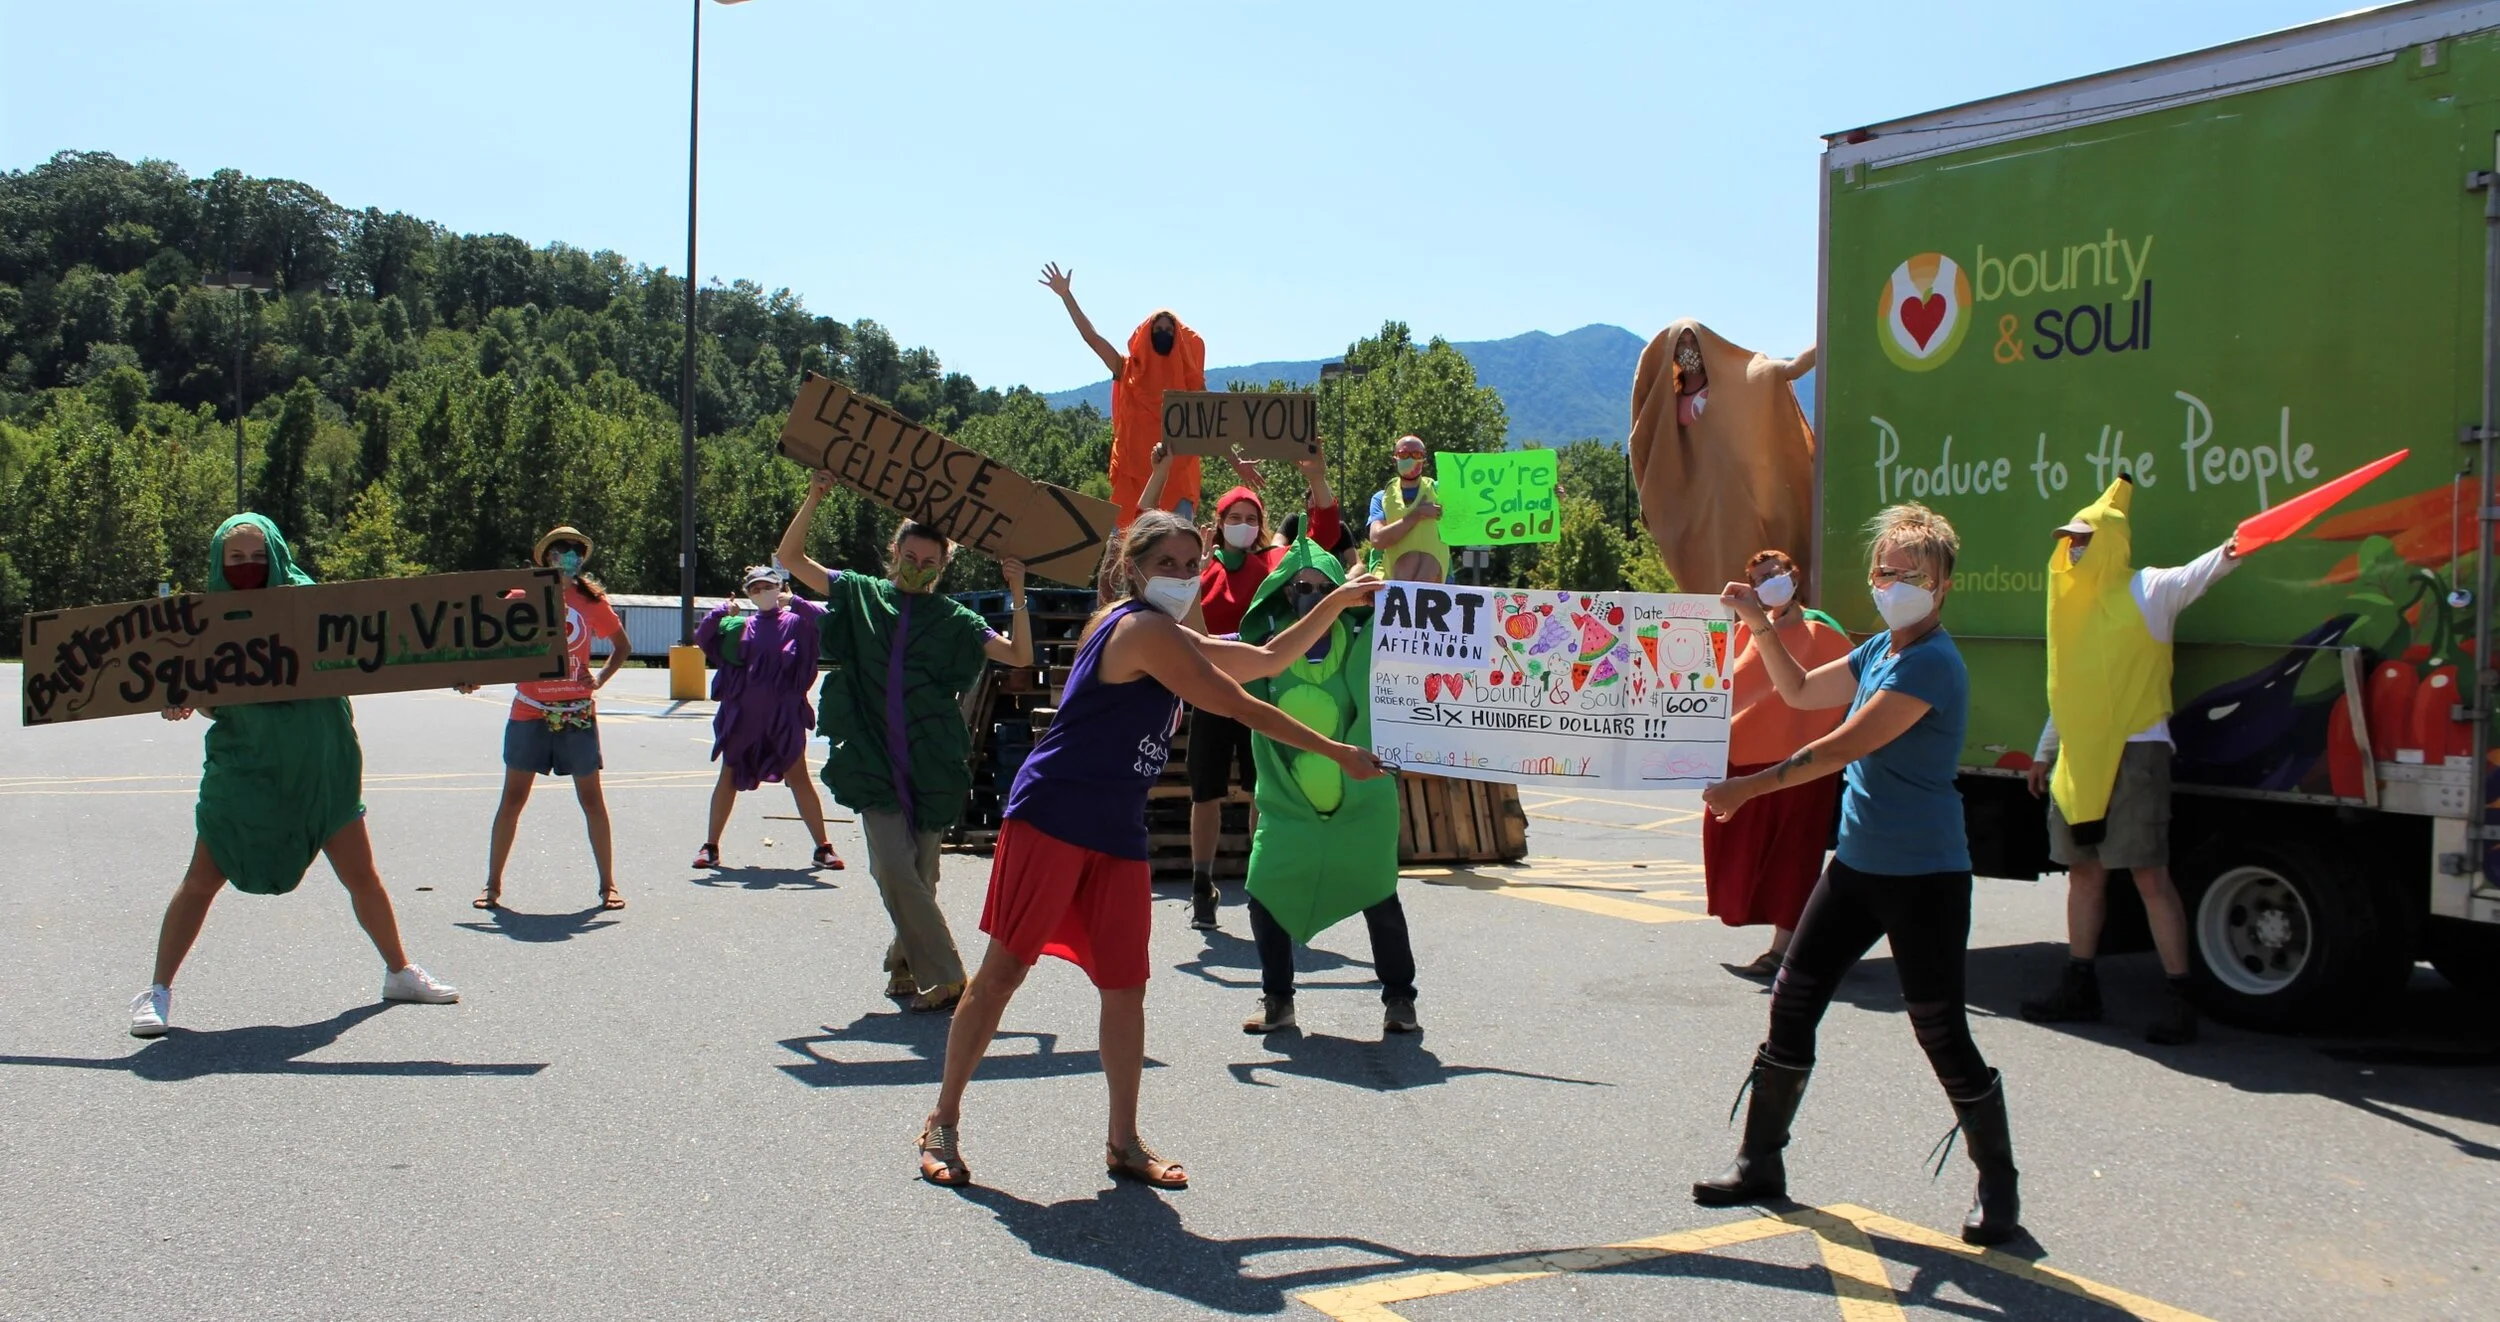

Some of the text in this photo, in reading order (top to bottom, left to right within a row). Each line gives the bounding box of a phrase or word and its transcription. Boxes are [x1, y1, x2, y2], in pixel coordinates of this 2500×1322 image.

[1976, 228, 2153, 301] bounty
[1993, 279, 2152, 364] & soul
[814, 385, 1001, 499] LETTUCE
[1164, 399, 1318, 454] OLIVE YOU!
[1870, 390, 2319, 512] Produce to the People
[1453, 455, 1549, 489] You're
[823, 436, 1012, 554] CELEBRATE
[1476, 487, 1553, 515] Salad
[1485, 510, 1555, 539] Gold
[1381, 586, 1484, 634] ART
[1634, 606, 1662, 621] Date
[318, 586, 557, 673] my Vibe!
[1377, 633, 1482, 660] AFTERNOON
[1414, 630, 1468, 644] IN THE
[27, 595, 209, 717] Butternut
[119, 633, 299, 704] Squash
[1376, 672, 1419, 686] PAY TO
[1376, 685, 1394, 696] THE
[1474, 674, 1542, 708] bounty
[1549, 677, 1570, 705] &
[1409, 703, 1463, 726] SIX
[1472, 710, 1552, 731] HUNDRED
[1560, 717, 1635, 736] DOLLARS
[1376, 745, 1403, 764] FOR
[1405, 741, 1455, 766] Feedng
[1464, 751, 1489, 768] the
